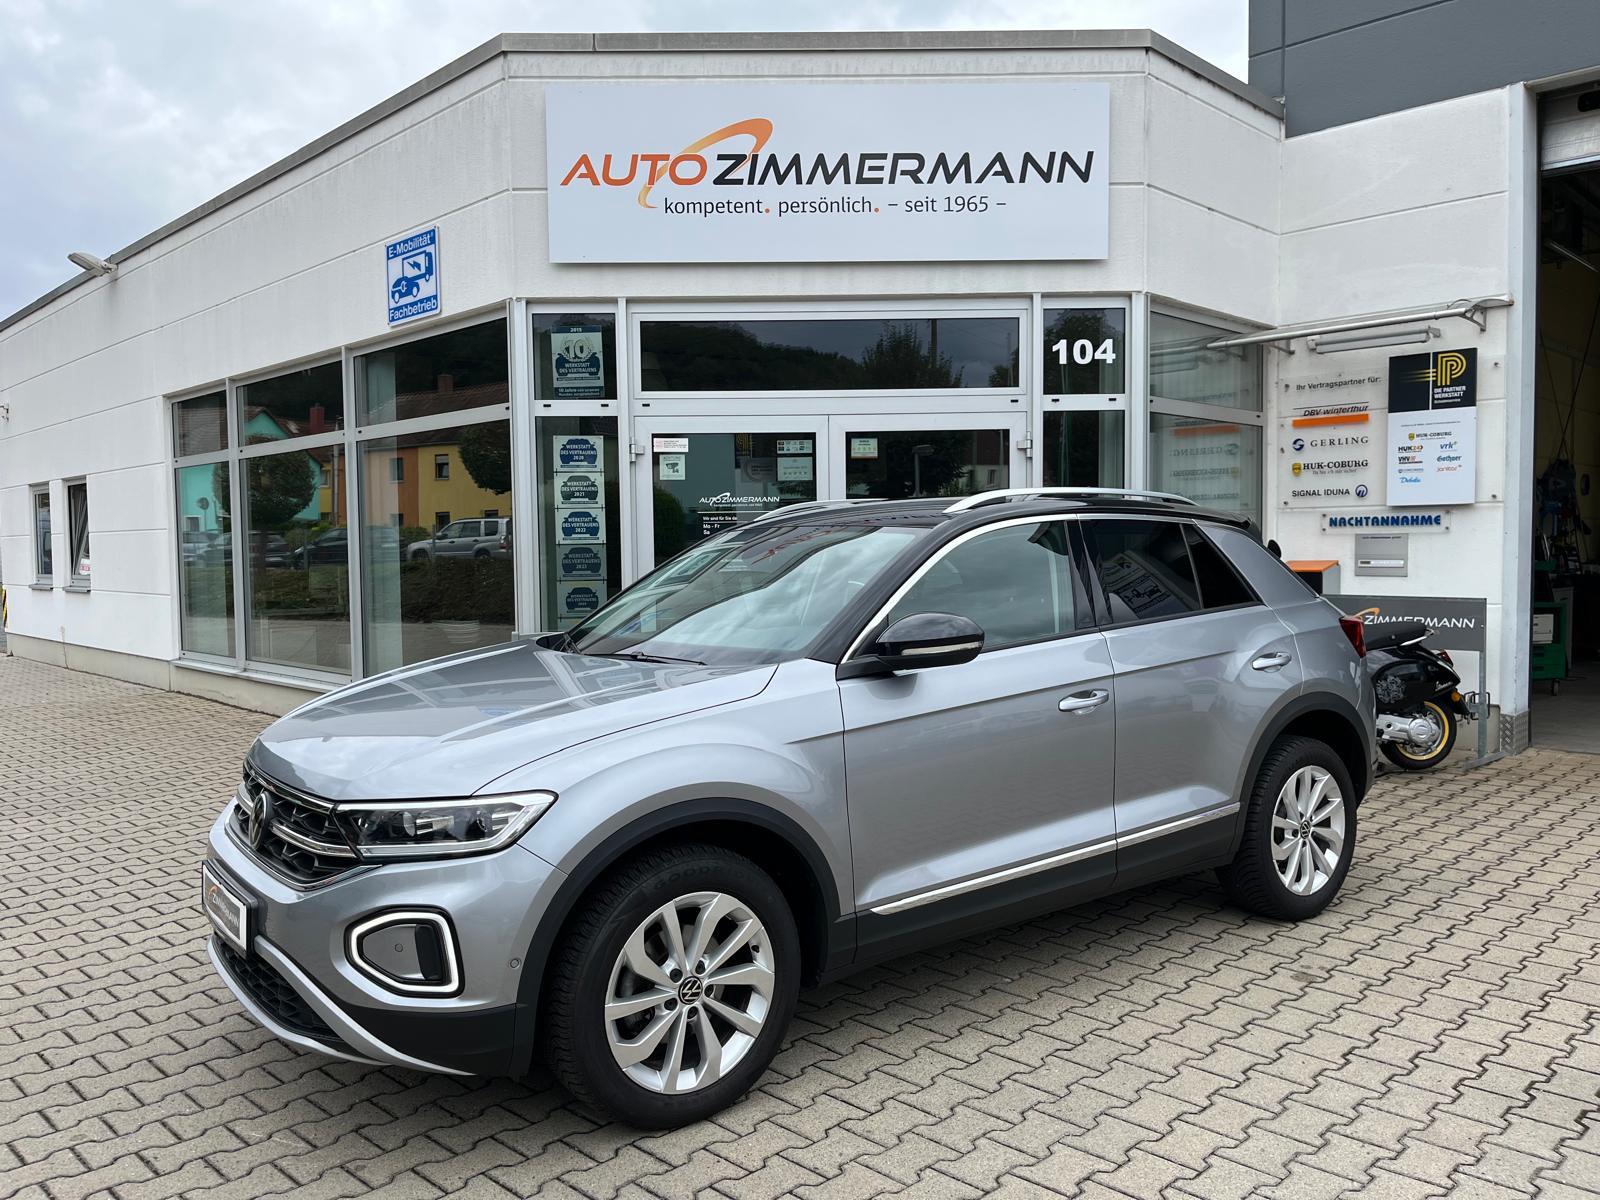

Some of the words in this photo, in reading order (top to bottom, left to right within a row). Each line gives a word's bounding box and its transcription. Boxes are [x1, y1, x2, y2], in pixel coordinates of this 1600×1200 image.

[560, 153, 708, 187] AUTO
[712, 150, 1095, 187] ZIMMERMANN
[664, 197, 771, 217] kompetent.
[778, 195, 881, 216] persönlich.
[904, 196, 938, 213] seit
[943, 195, 989, 213] 1965
[389, 297, 437, 321] Fachbetrieb
[1051, 338, 1117, 365] 104
[1307, 377, 1367, 389] Vertragspartner
[1433, 391, 1464, 399] WERKSTATT
[1310, 436, 1369, 447] GERLING
[1303, 459, 1368, 470] HUK-COBURG
[1292, 489, 1322, 498] SIGNAL
[1323, 488, 1350, 496] IDUNA
[1329, 514, 1441, 528] NACHTANNAHME
